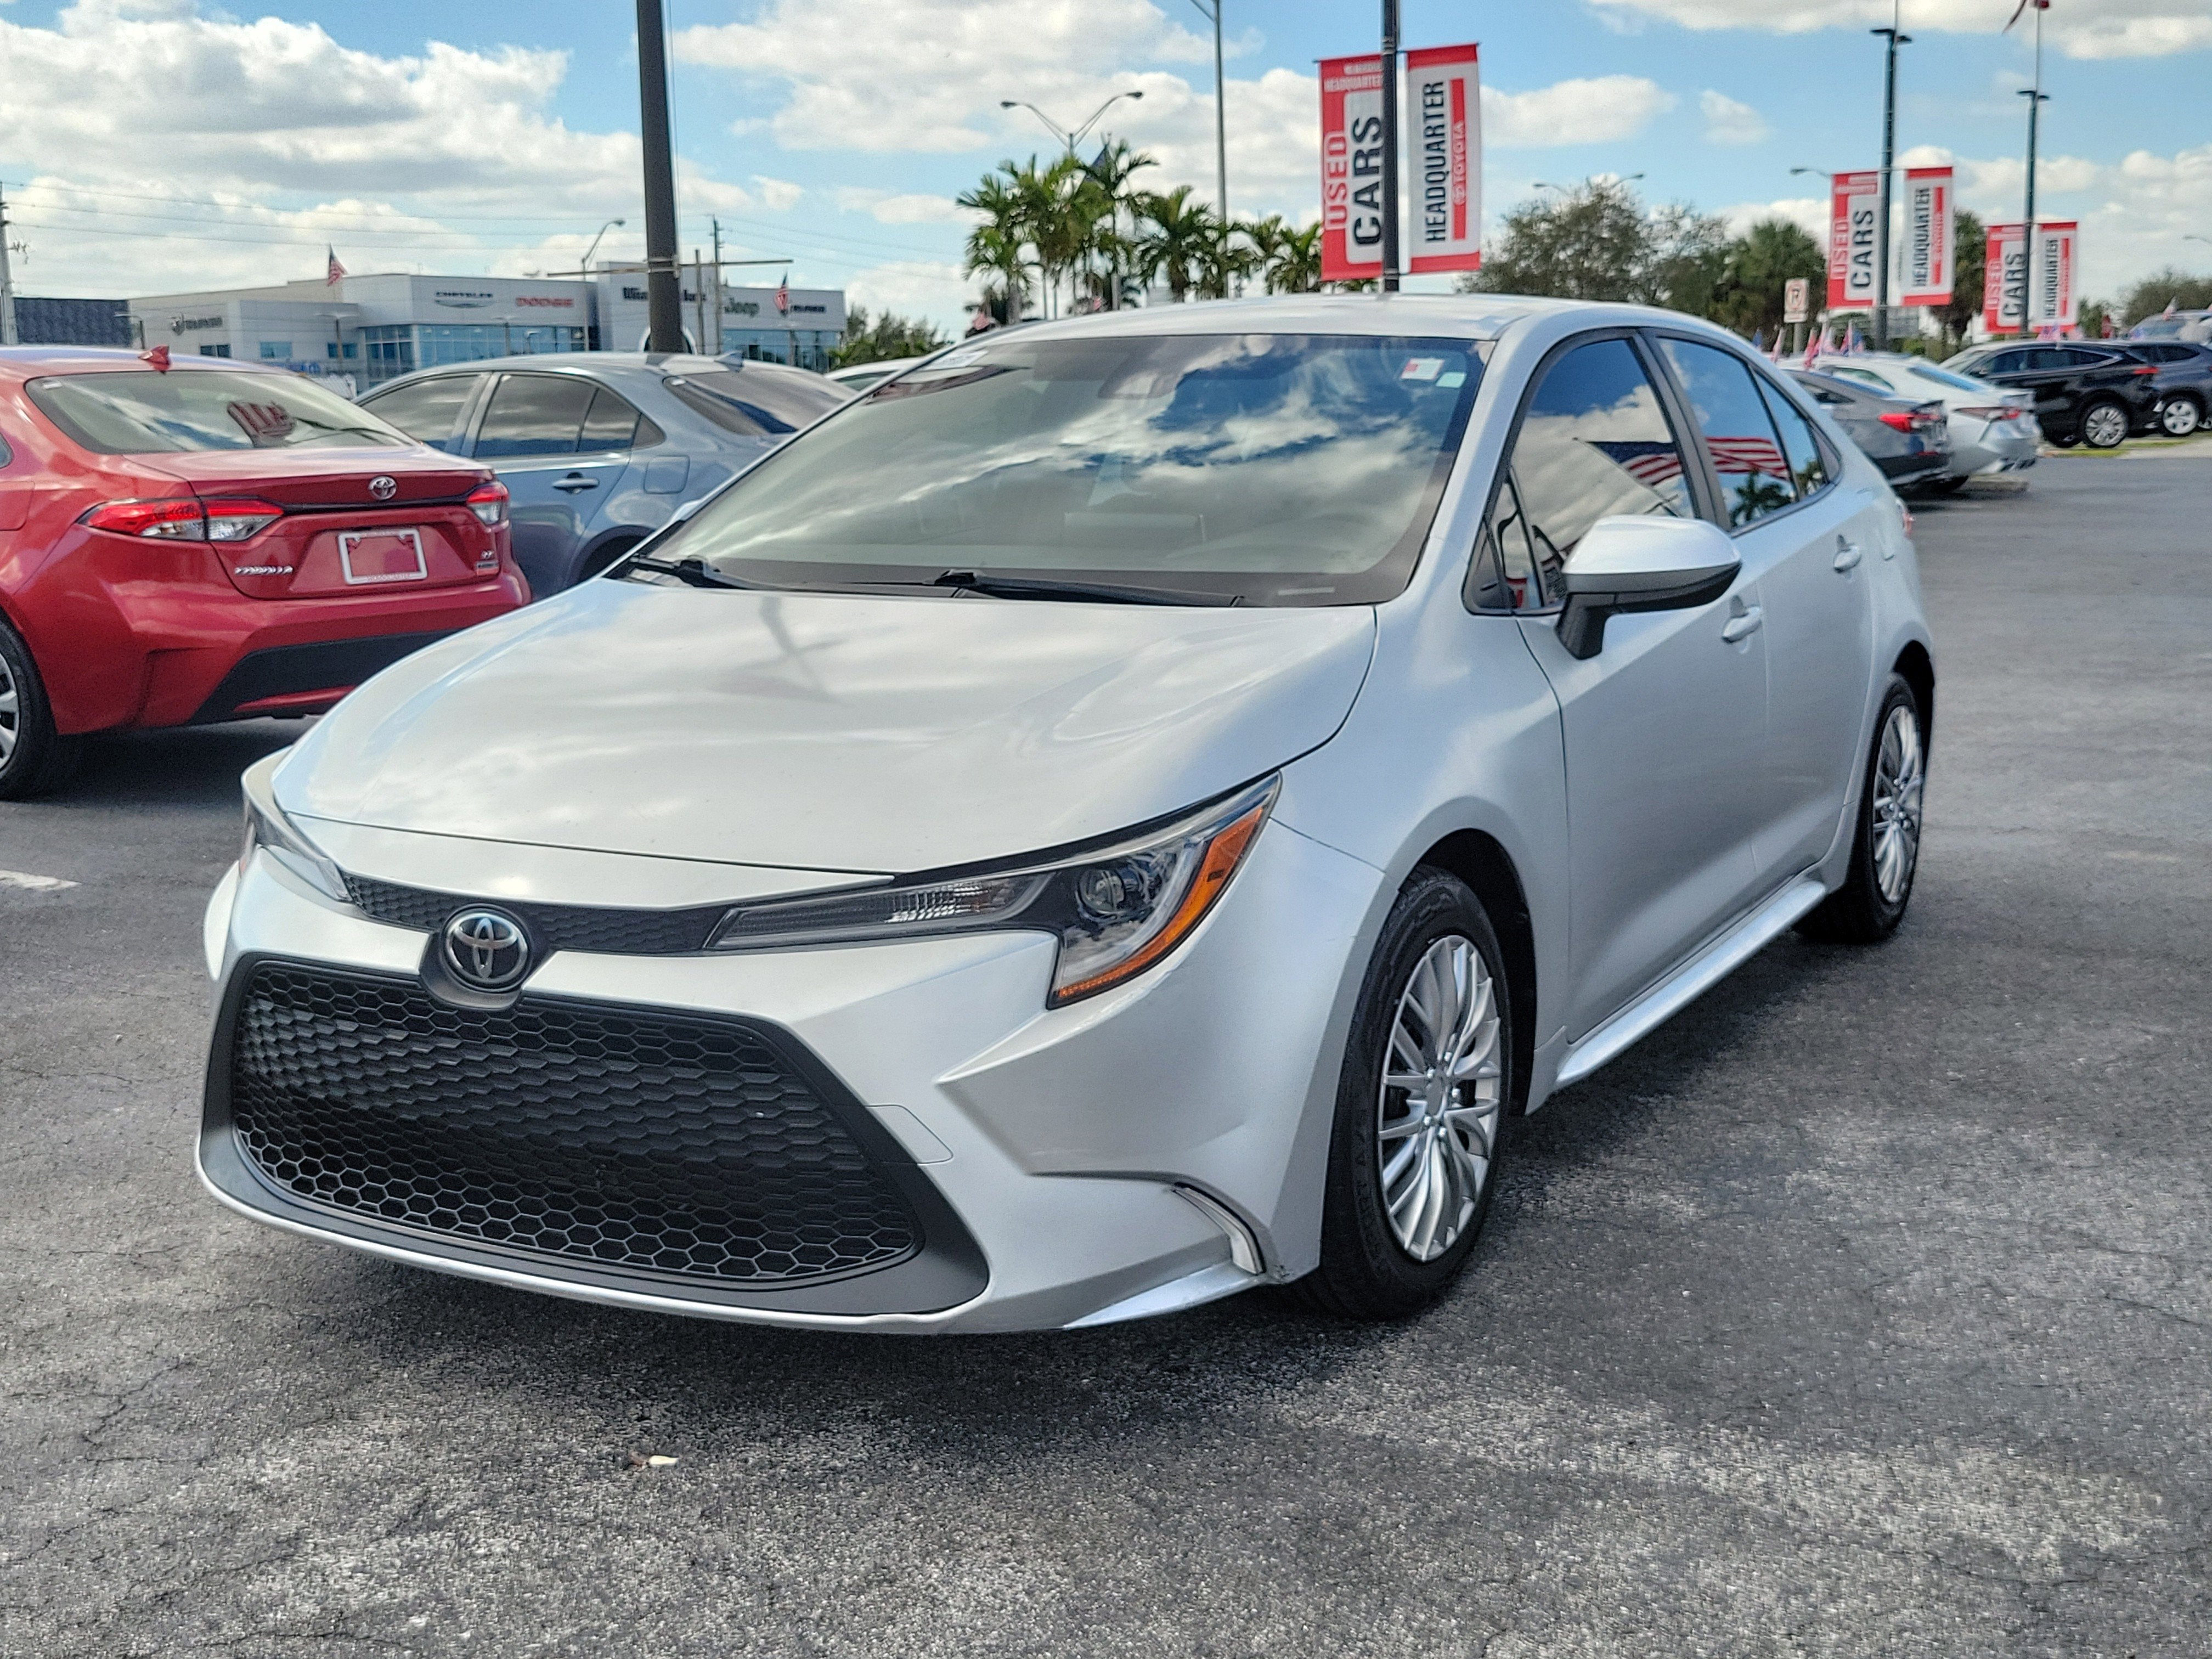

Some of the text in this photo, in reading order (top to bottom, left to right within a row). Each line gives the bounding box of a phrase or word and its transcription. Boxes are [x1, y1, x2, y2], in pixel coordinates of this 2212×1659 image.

[1324, 132, 1348, 230] USED
[1353, 116, 1382, 245] CARS
[1423, 81, 1449, 242] HEADQUARTER
[1830, 218, 1848, 279] USED
[1852, 210, 1873, 289] CARS
[1912, 187, 1931, 287] HEADQUARTER
[1985, 259, 2002, 310] USED
[2003, 252, 2026, 318] CARS
